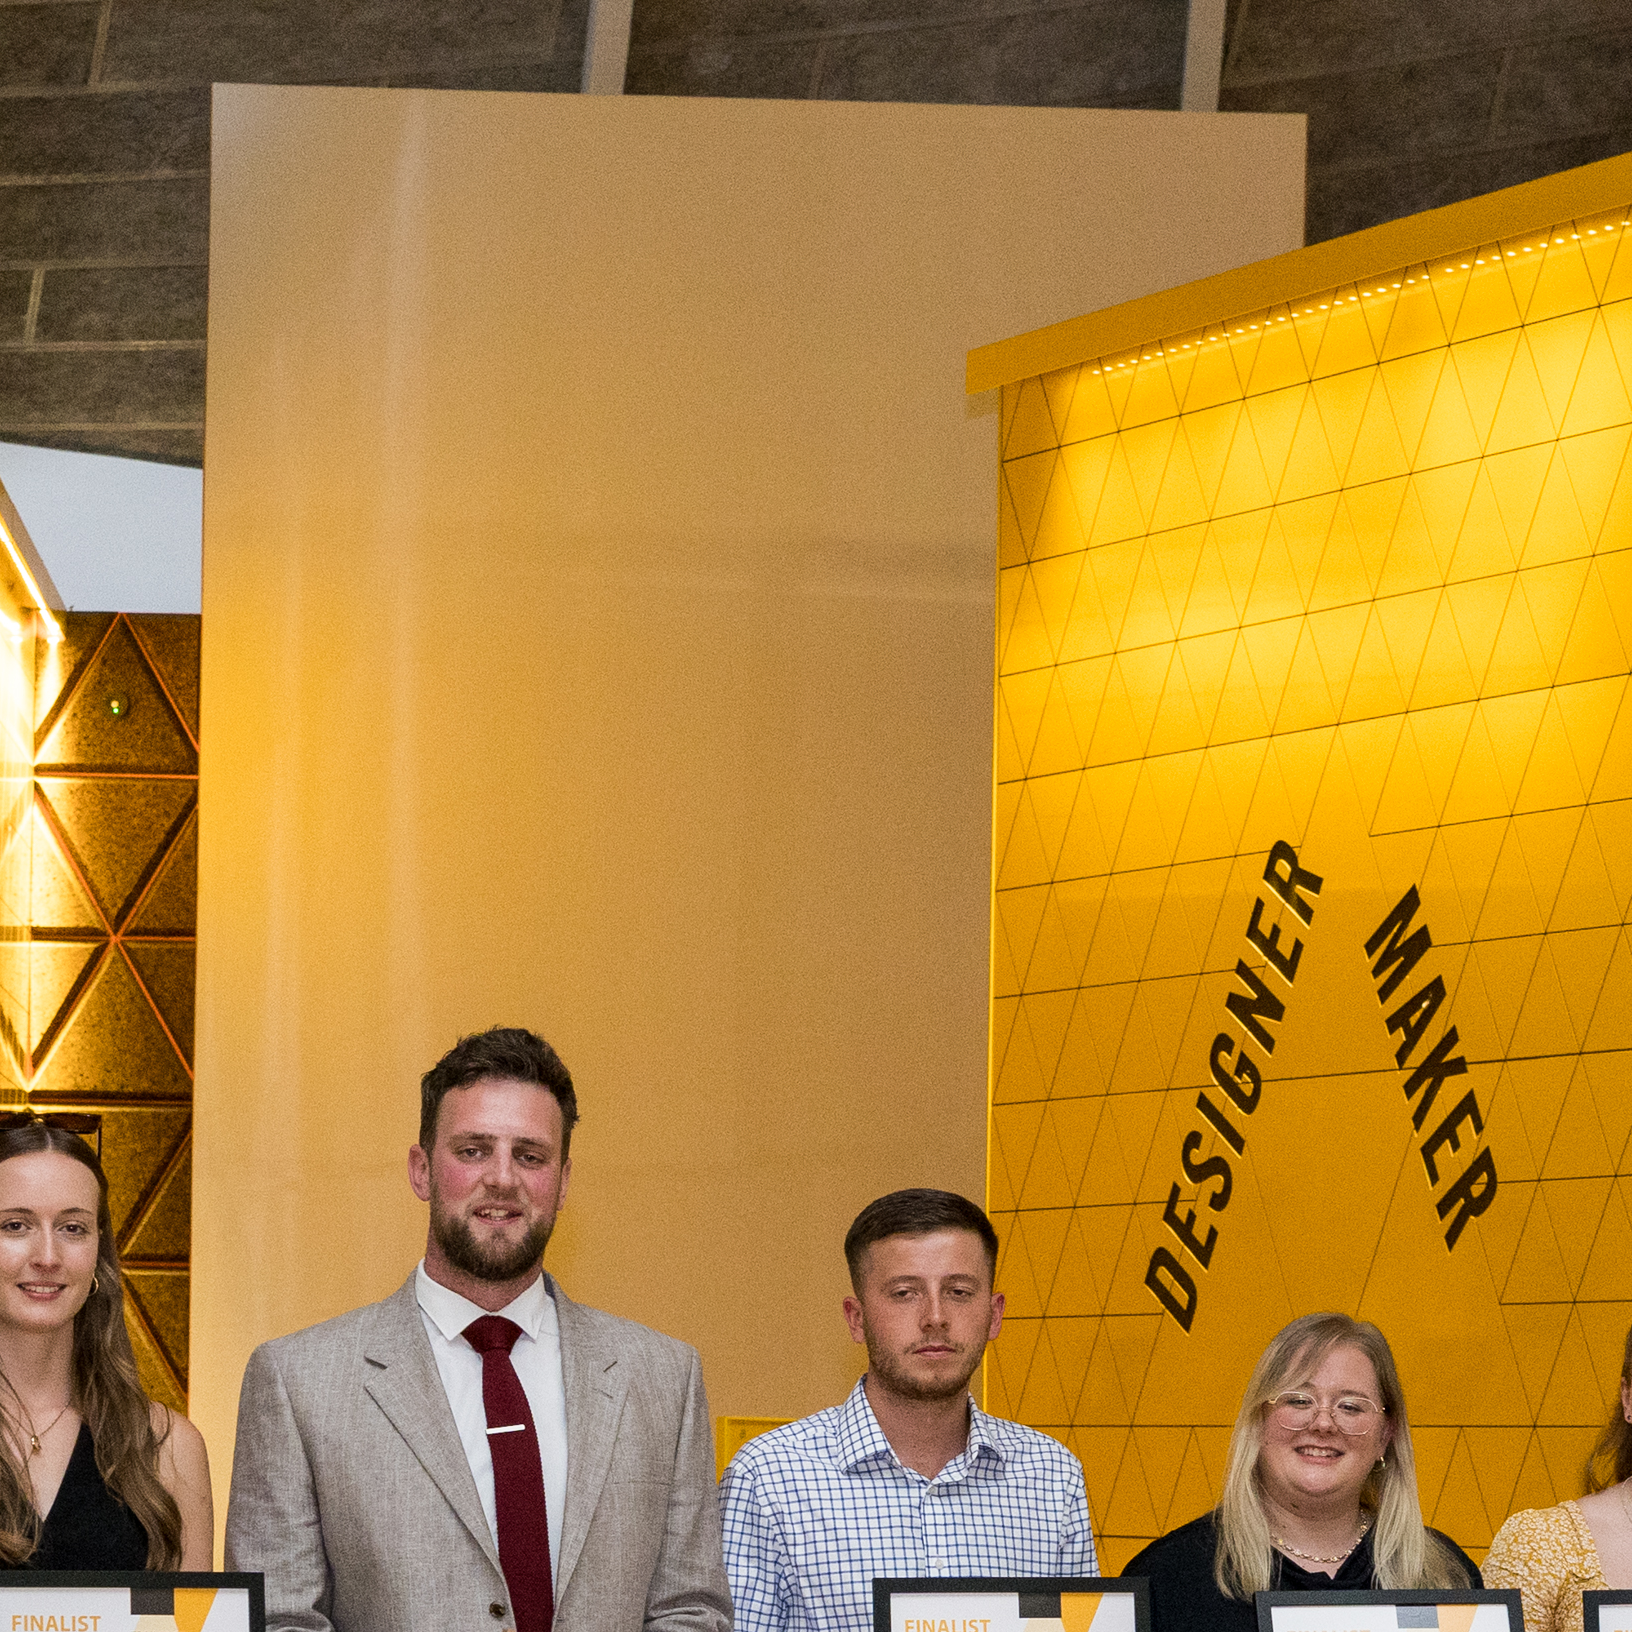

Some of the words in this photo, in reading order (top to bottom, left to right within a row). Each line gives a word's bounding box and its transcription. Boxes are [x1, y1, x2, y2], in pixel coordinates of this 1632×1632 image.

[1145, 839, 1323, 1334] DESIGNER
[1364, 883, 1498, 1253] MAKER
[11, 1614, 101, 1632] FINALIST
